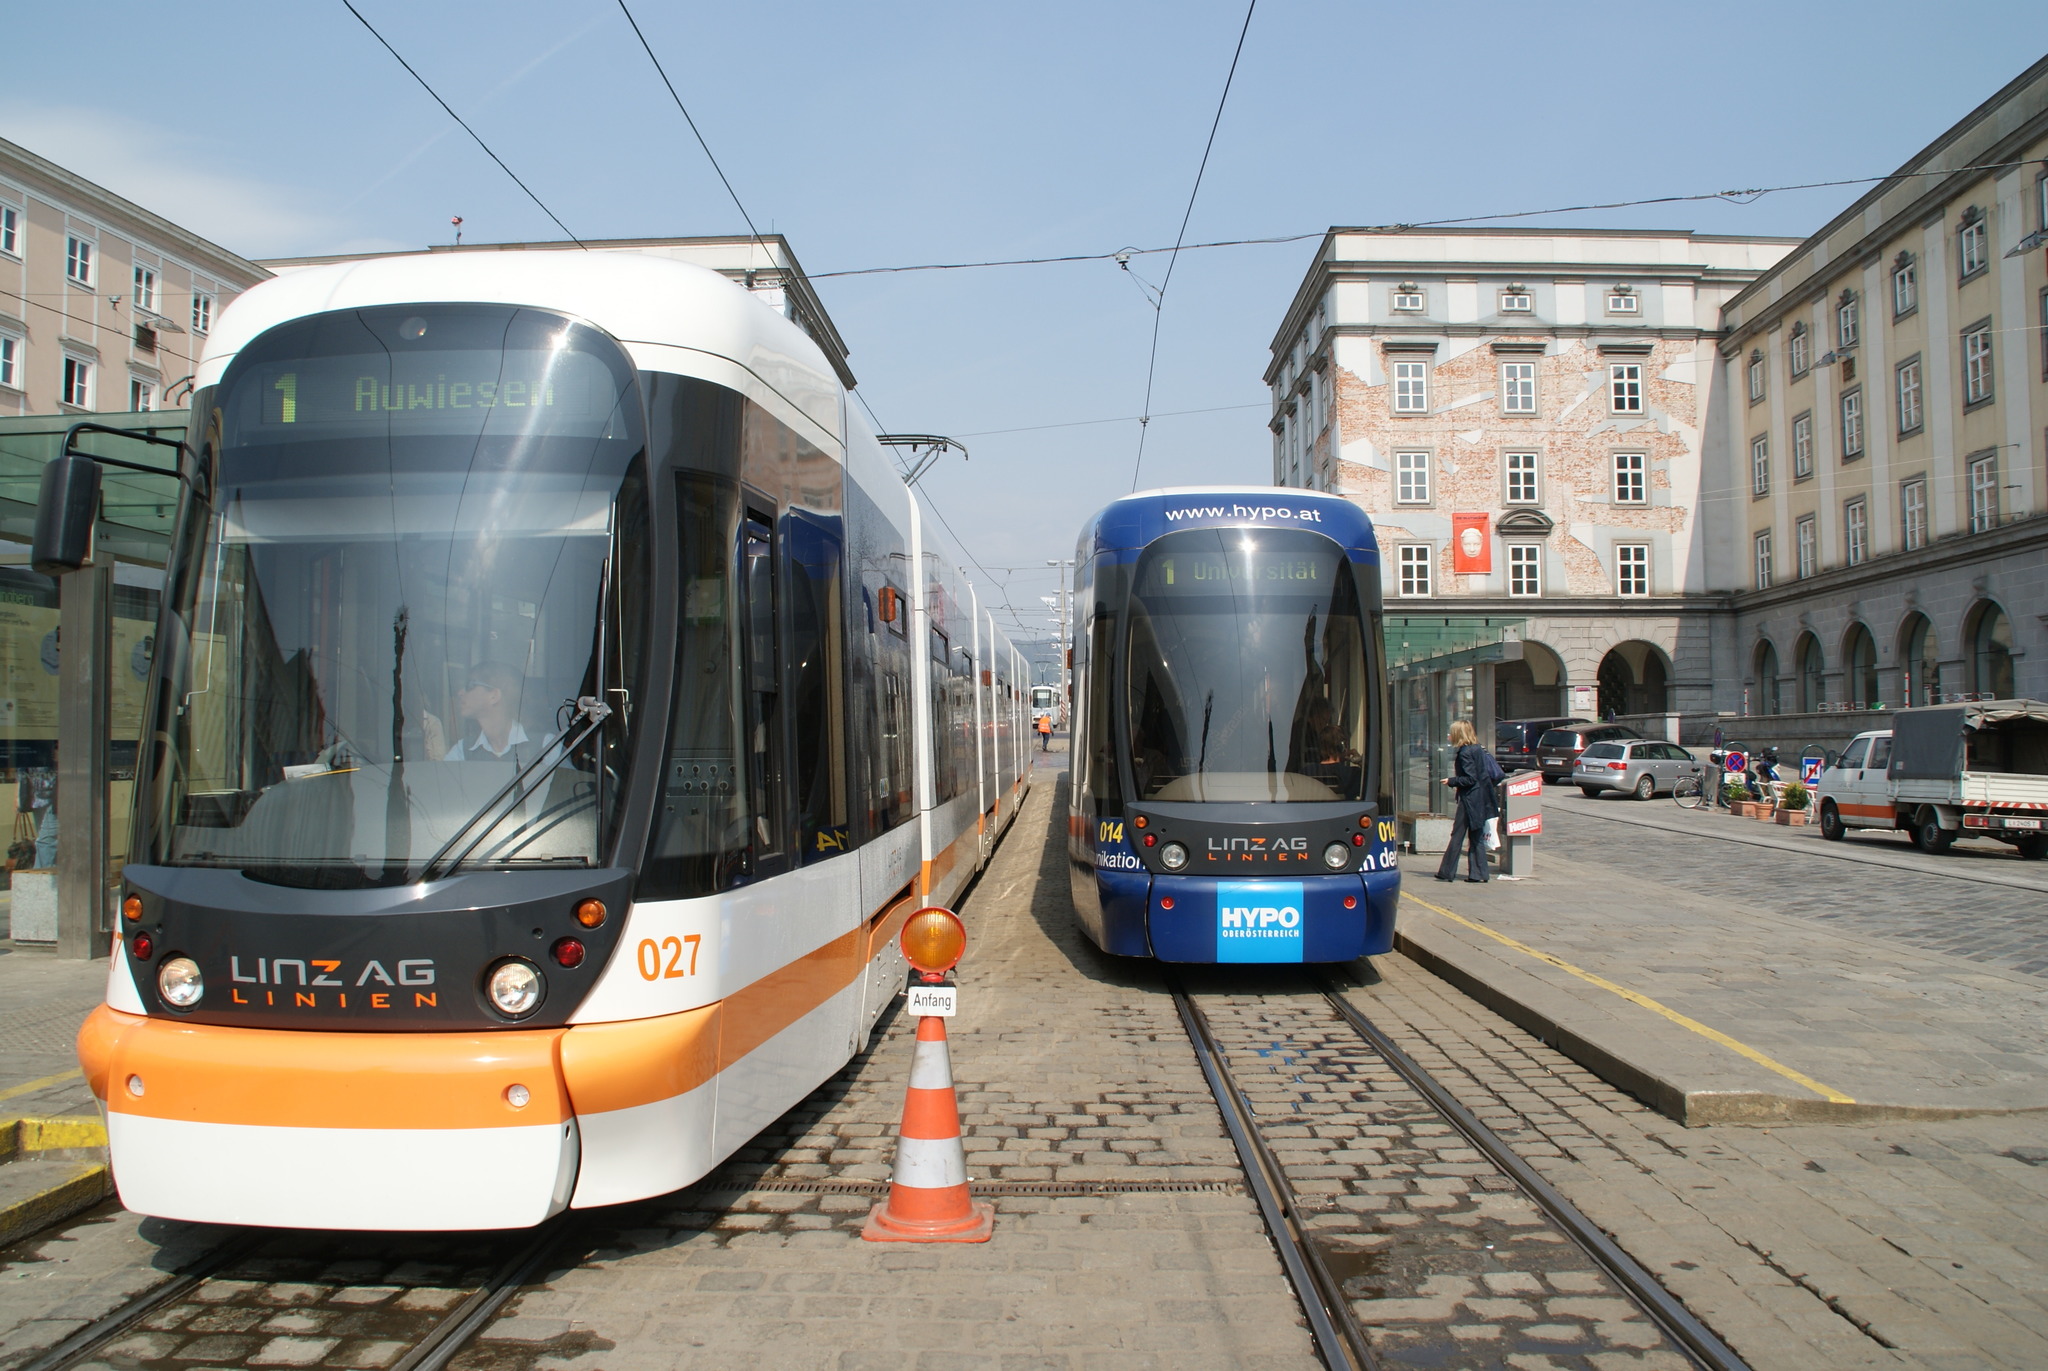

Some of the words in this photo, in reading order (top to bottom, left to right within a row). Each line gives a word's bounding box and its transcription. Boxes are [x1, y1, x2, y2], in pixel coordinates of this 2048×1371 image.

[274, 373, 297, 424] 1
[354, 373, 555, 412] Auwiesen
[1165, 503, 1322, 523] www.hypo.at
[1161, 559, 1175, 585] 1
[1508, 780, 1538, 796] Heute
[1100, 821, 1124, 844] 014
[1508, 817, 1538, 833] Heute
[1207, 837, 1267, 851] LINZ
[1271, 837, 1308, 851] AG
[1207, 852, 1309, 862] LINIEN
[1221, 906, 1300, 928] HYPO
[1222, 927, 1300, 938] OBERÖSTERREICH
[637, 933, 702, 982] 027
[230, 955, 343, 987] LINZ
[355, 958, 436, 987] AG
[231, 988, 437, 1009] LINIEN
[913, 992, 952, 1011] Anfang
